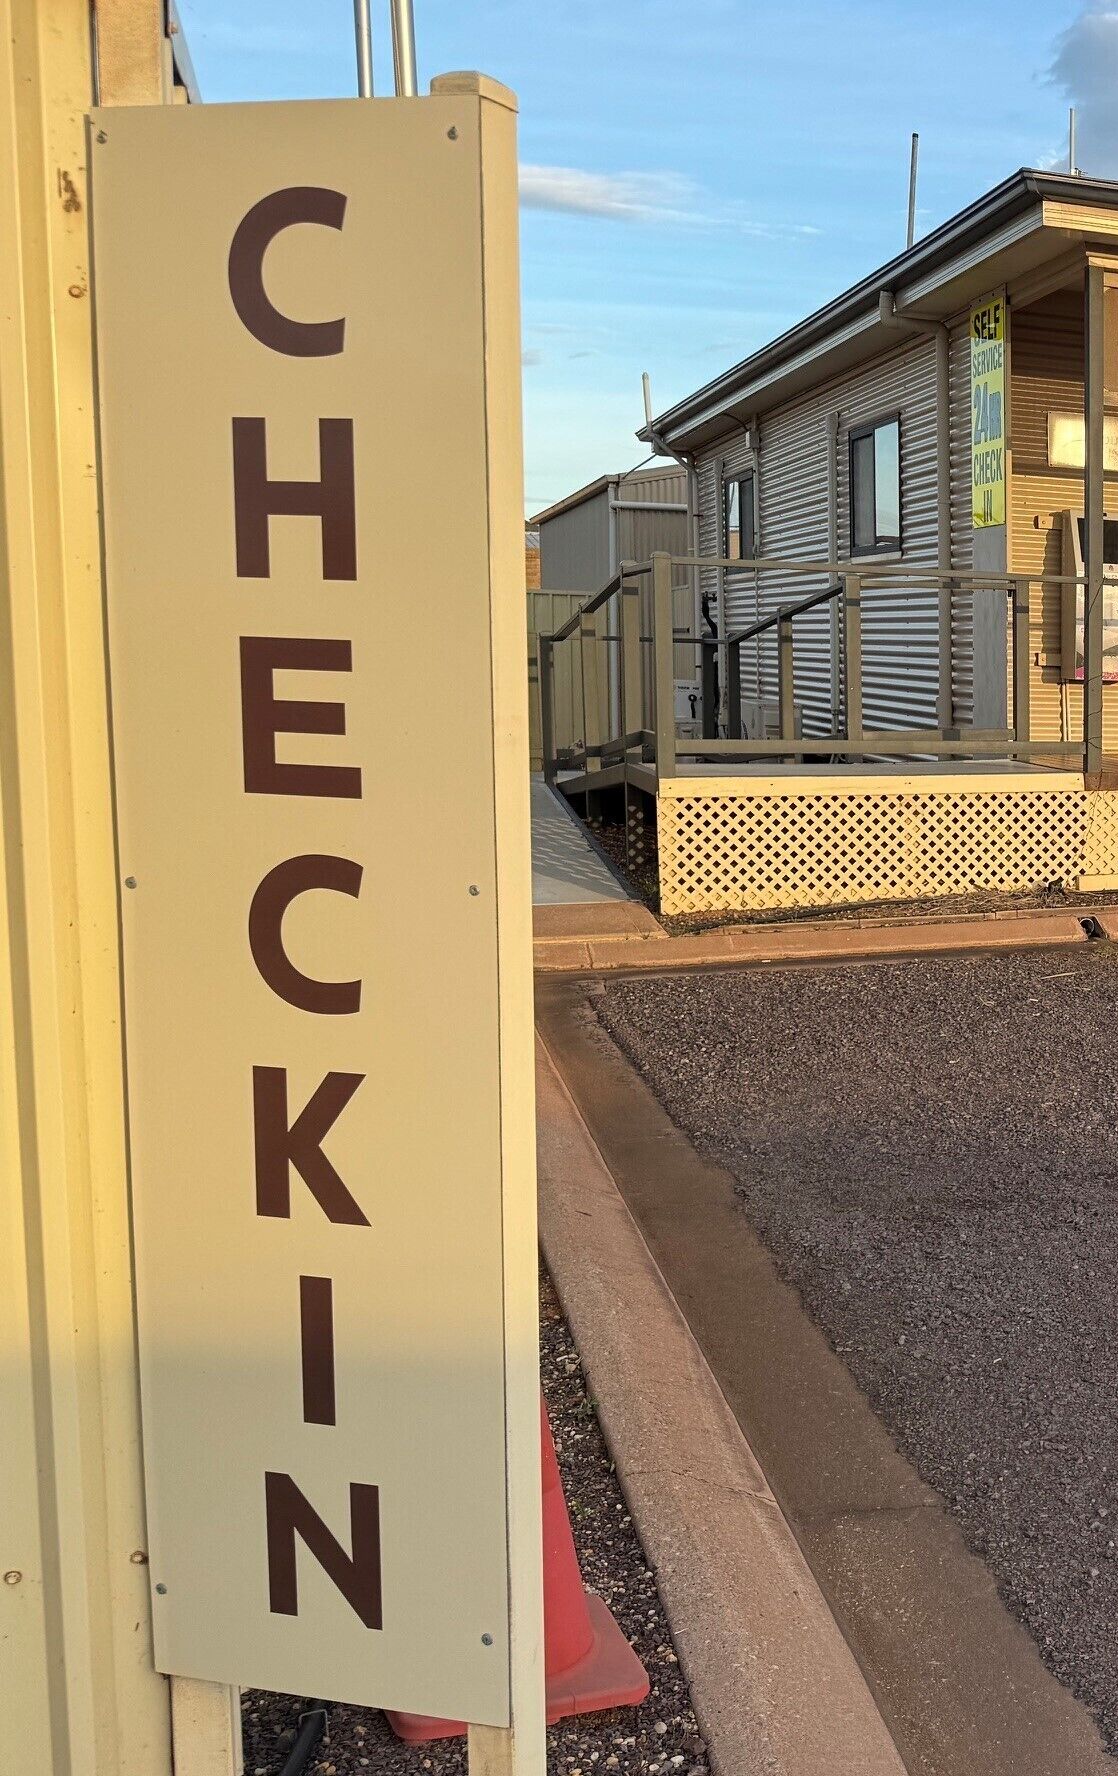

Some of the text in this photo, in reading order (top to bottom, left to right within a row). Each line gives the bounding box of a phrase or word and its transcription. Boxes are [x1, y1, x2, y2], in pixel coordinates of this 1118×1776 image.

[973, 303, 1000, 347] SELF
[973, 342, 1002, 378] SERVICE
[974, 447, 1002, 487] CHECK
[983, 489, 993, 522] IN
